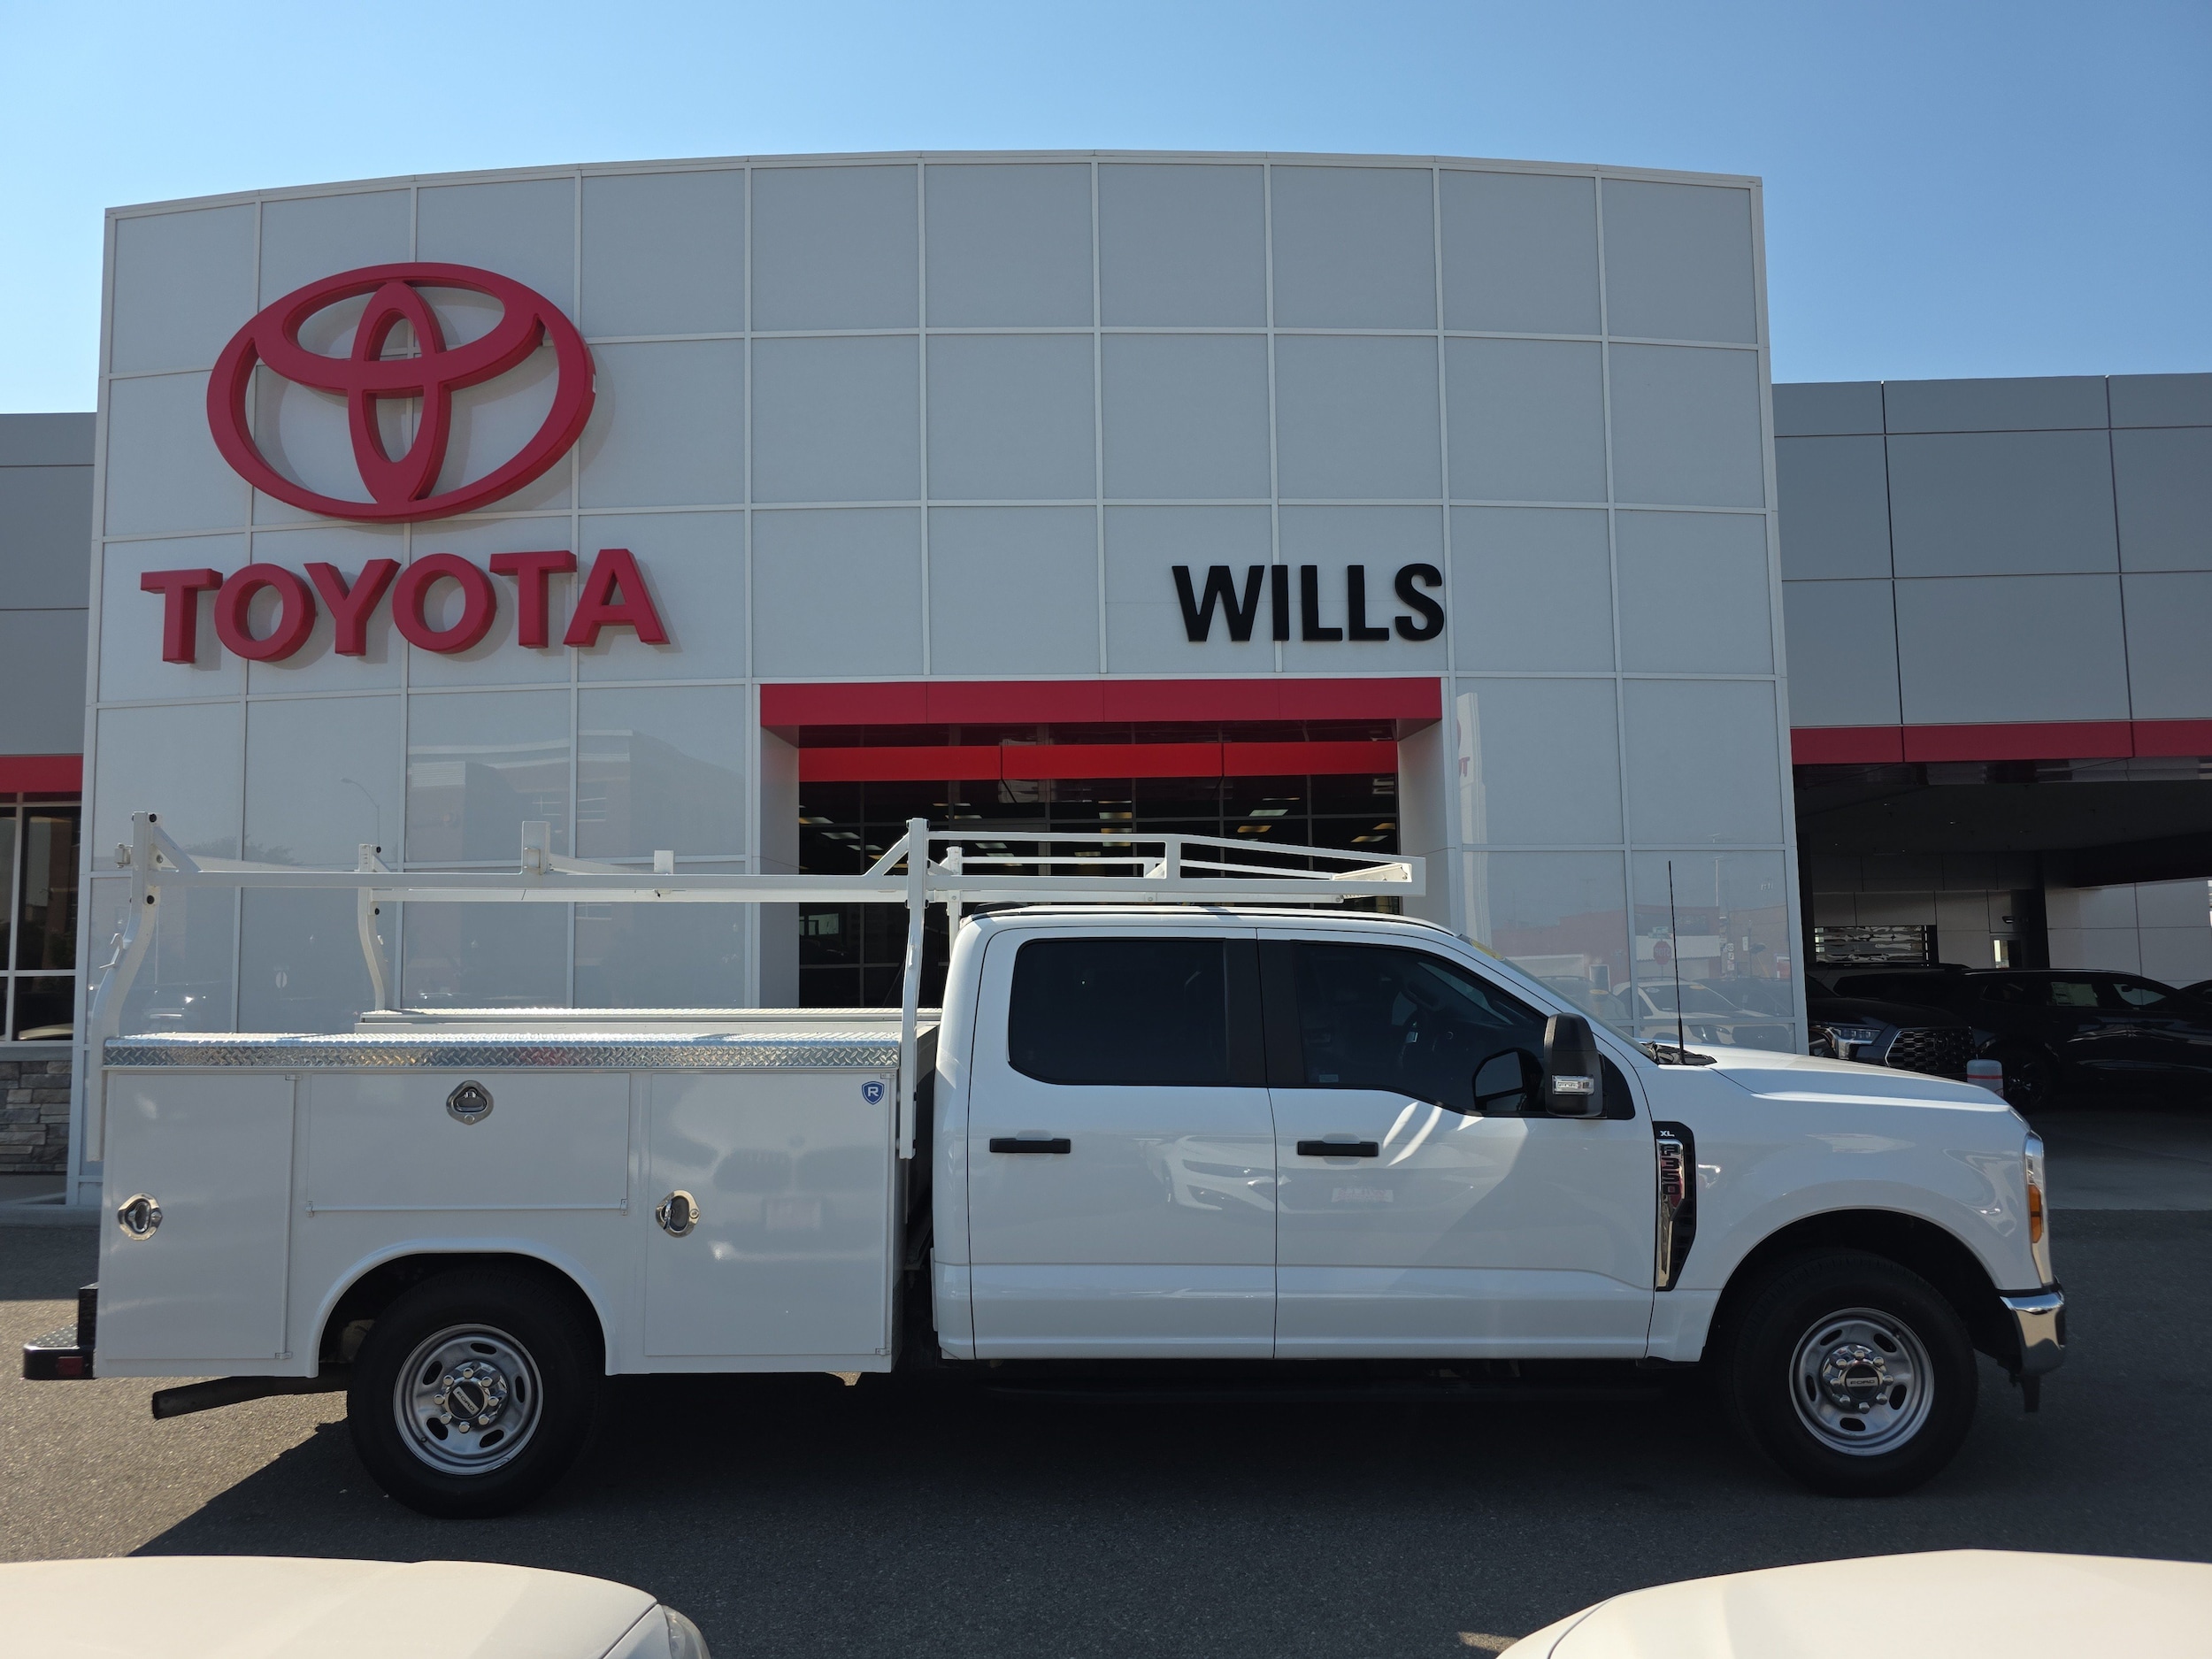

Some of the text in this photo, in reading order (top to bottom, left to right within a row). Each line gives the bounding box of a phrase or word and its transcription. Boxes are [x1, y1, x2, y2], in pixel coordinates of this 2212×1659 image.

[140, 548, 670, 664] TOYOTA
[1171, 563, 1445, 642] WILLS
[867, 1086, 879, 1097] R
[457, 1391, 475, 1411] FORD
